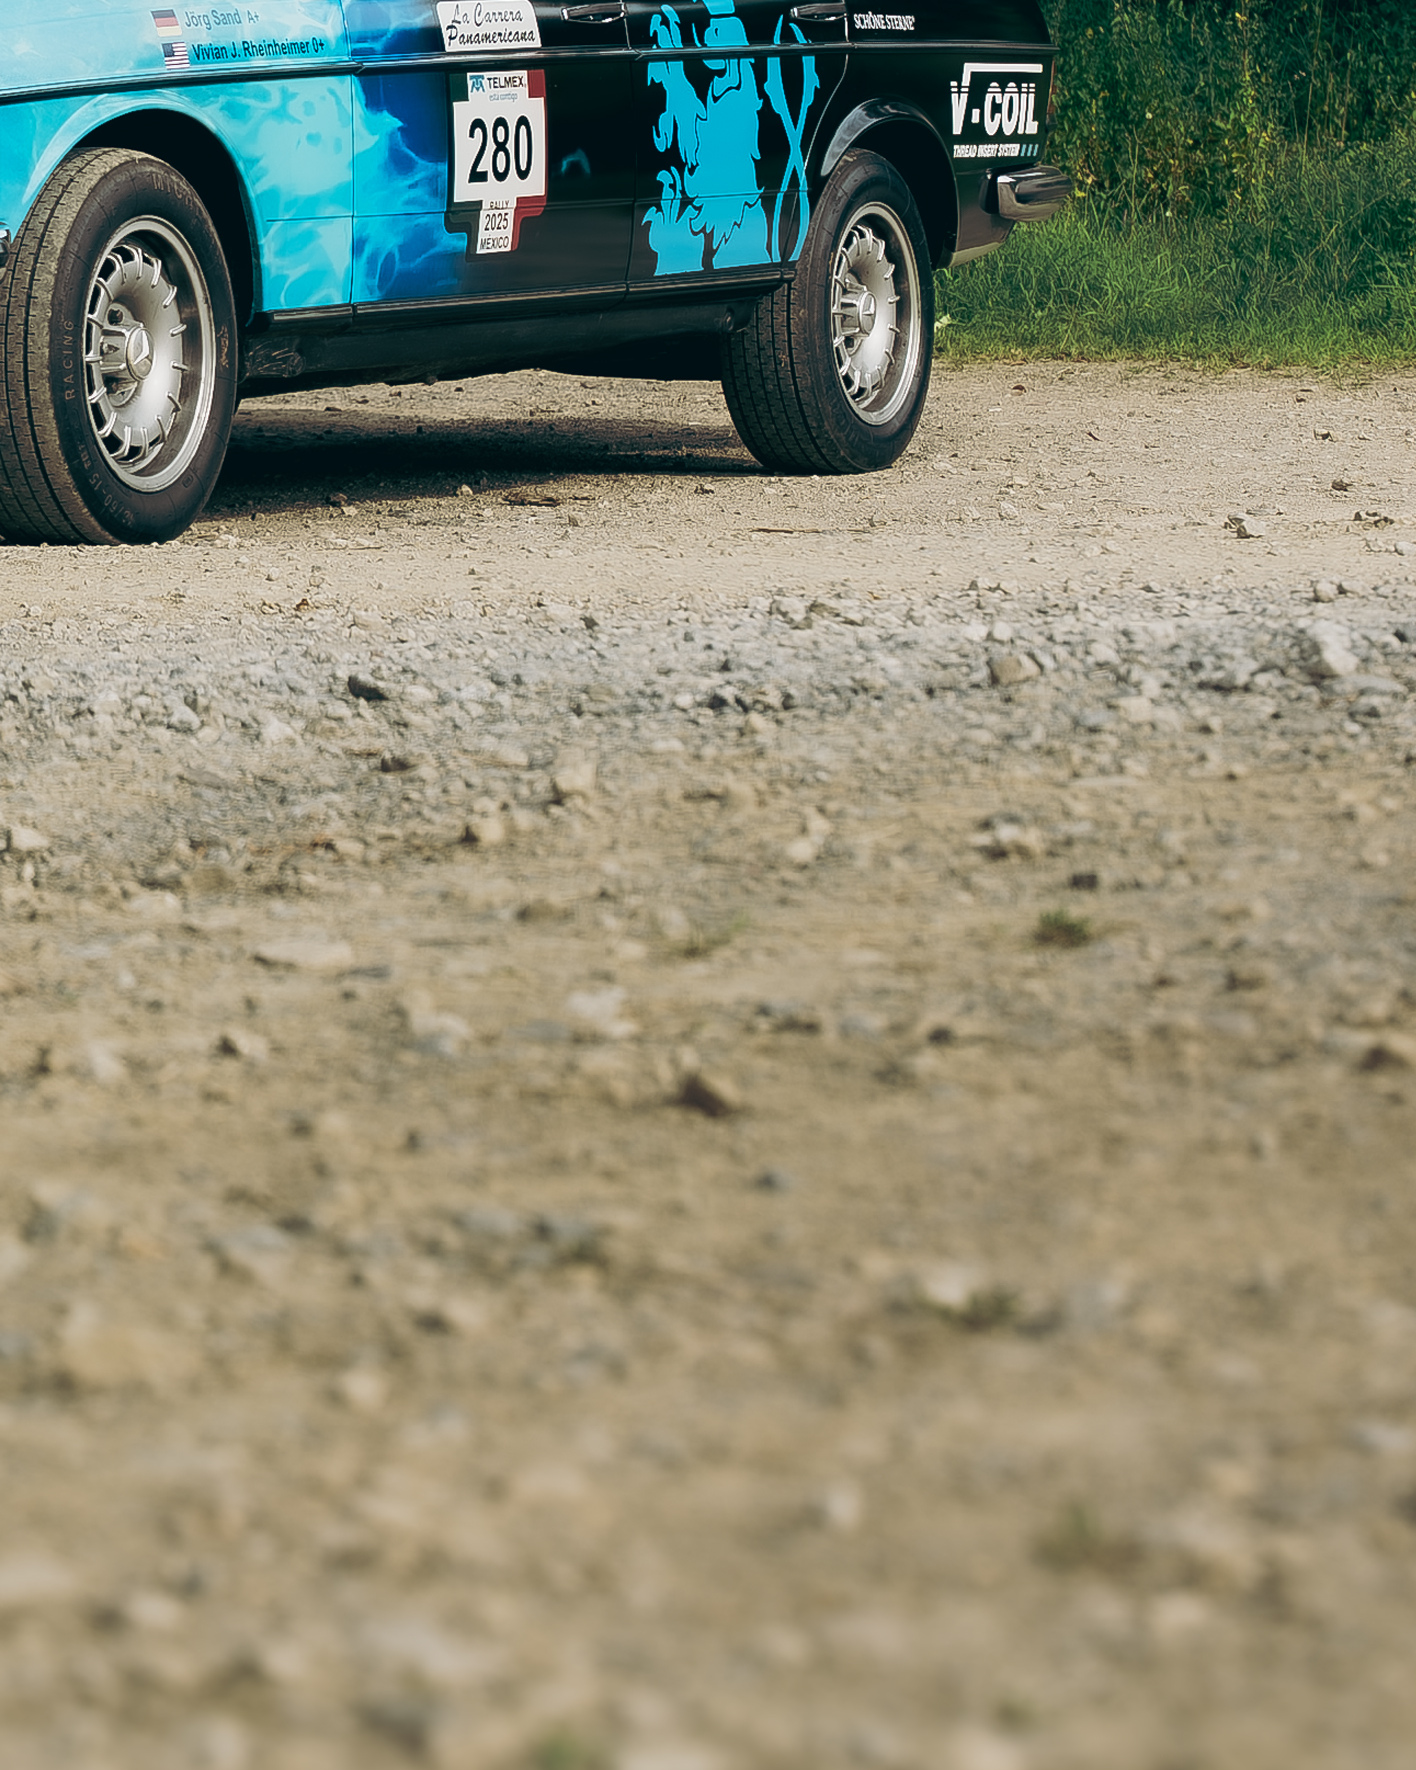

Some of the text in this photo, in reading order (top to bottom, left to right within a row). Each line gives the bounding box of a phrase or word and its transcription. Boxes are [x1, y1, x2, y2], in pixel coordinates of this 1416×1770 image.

[185, 9, 260, 30] Jörg Sand A+
[451, 2, 524, 27] La Carrera
[445, 24, 536, 48] Panamericana
[191, 43, 229, 61] Vivian
[231, 42, 241, 59] J.
[242, 38, 310, 57] Rheinheimer
[486, 75, 524, 89] TELMEX
[950, 63, 1043, 136] V-COIL
[467, 114, 534, 184] 280
[484, 212, 509, 231] 2025
[63, 320, 75, 400] RACING
